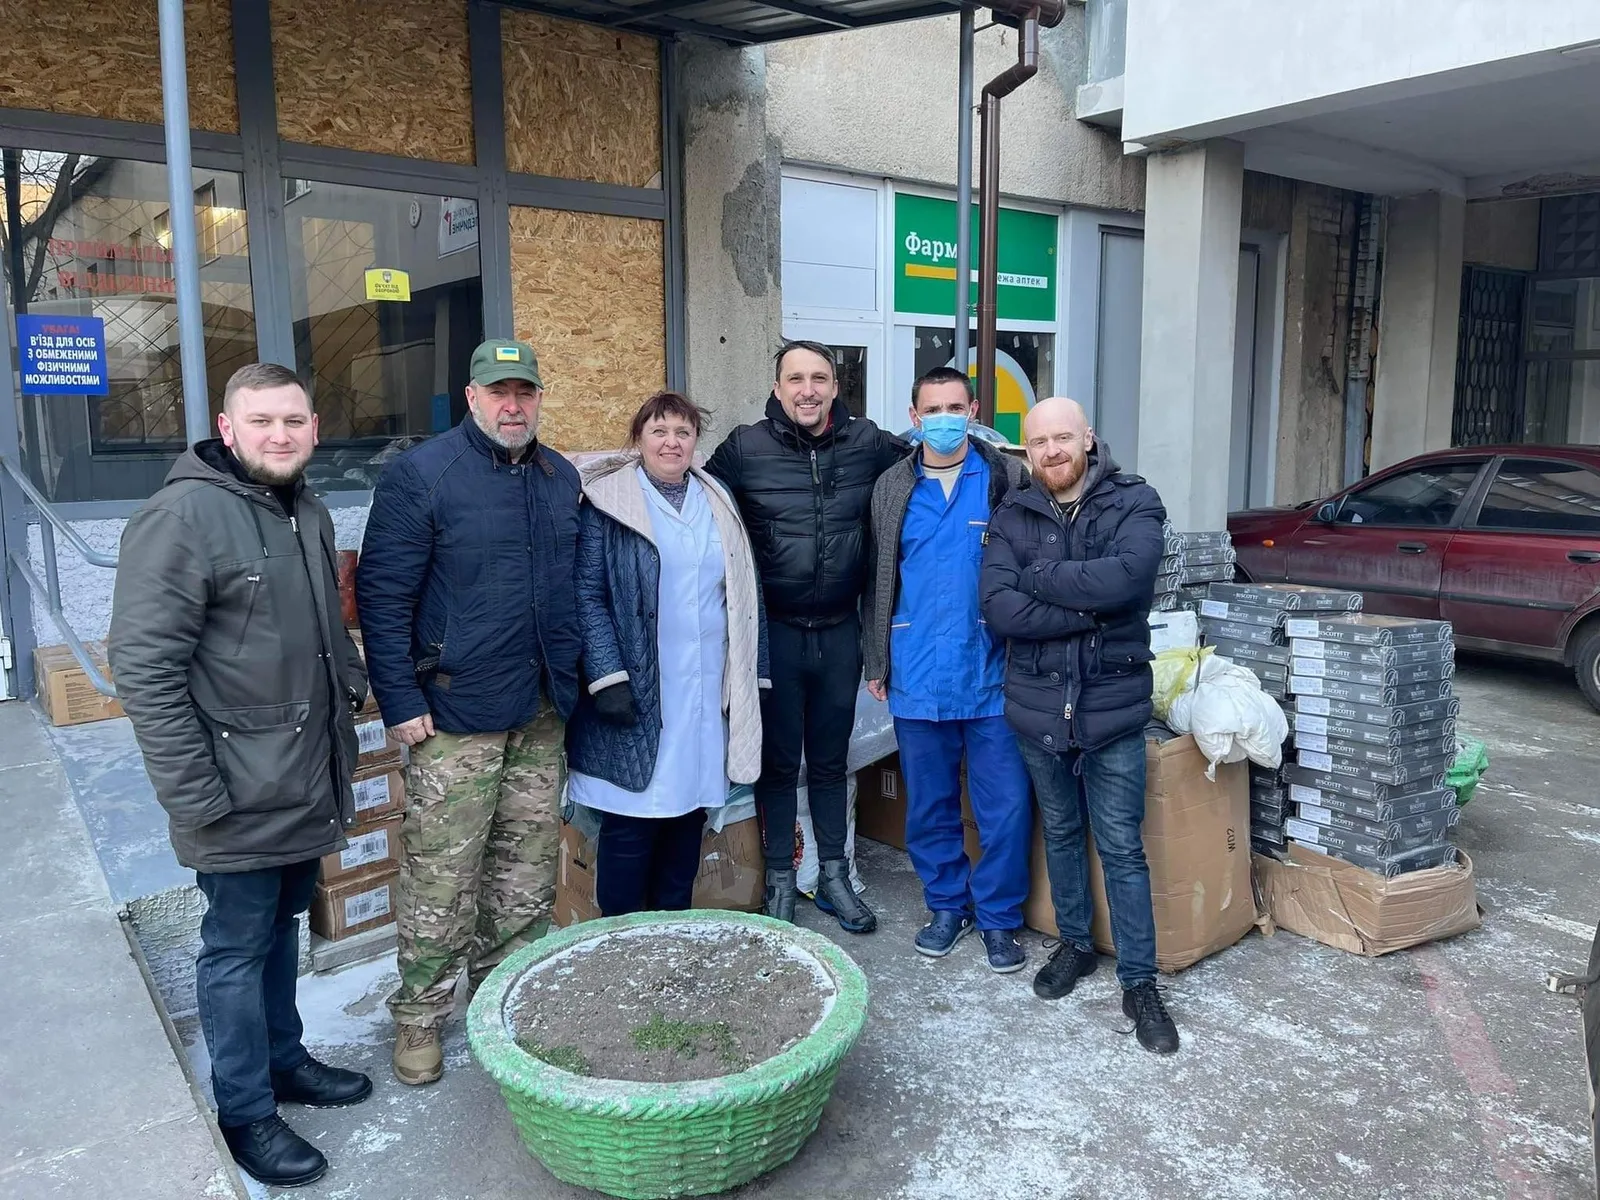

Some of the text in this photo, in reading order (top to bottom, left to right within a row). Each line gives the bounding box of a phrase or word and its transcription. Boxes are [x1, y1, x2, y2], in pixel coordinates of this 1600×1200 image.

[997, 274, 1041, 286] ежа аптек
[42, 324, 80, 334] УВАГА!
[30, 334, 96, 348] В'ЇЗД ДЛЯ ОСІБ
[28, 348, 98, 360] З ОБМЕЖЕНИМИ
[37, 361, 90, 373] ФІЗИЧНИМИ
[25, 374, 100, 385] МОЖЛИВОСТЯМИ
